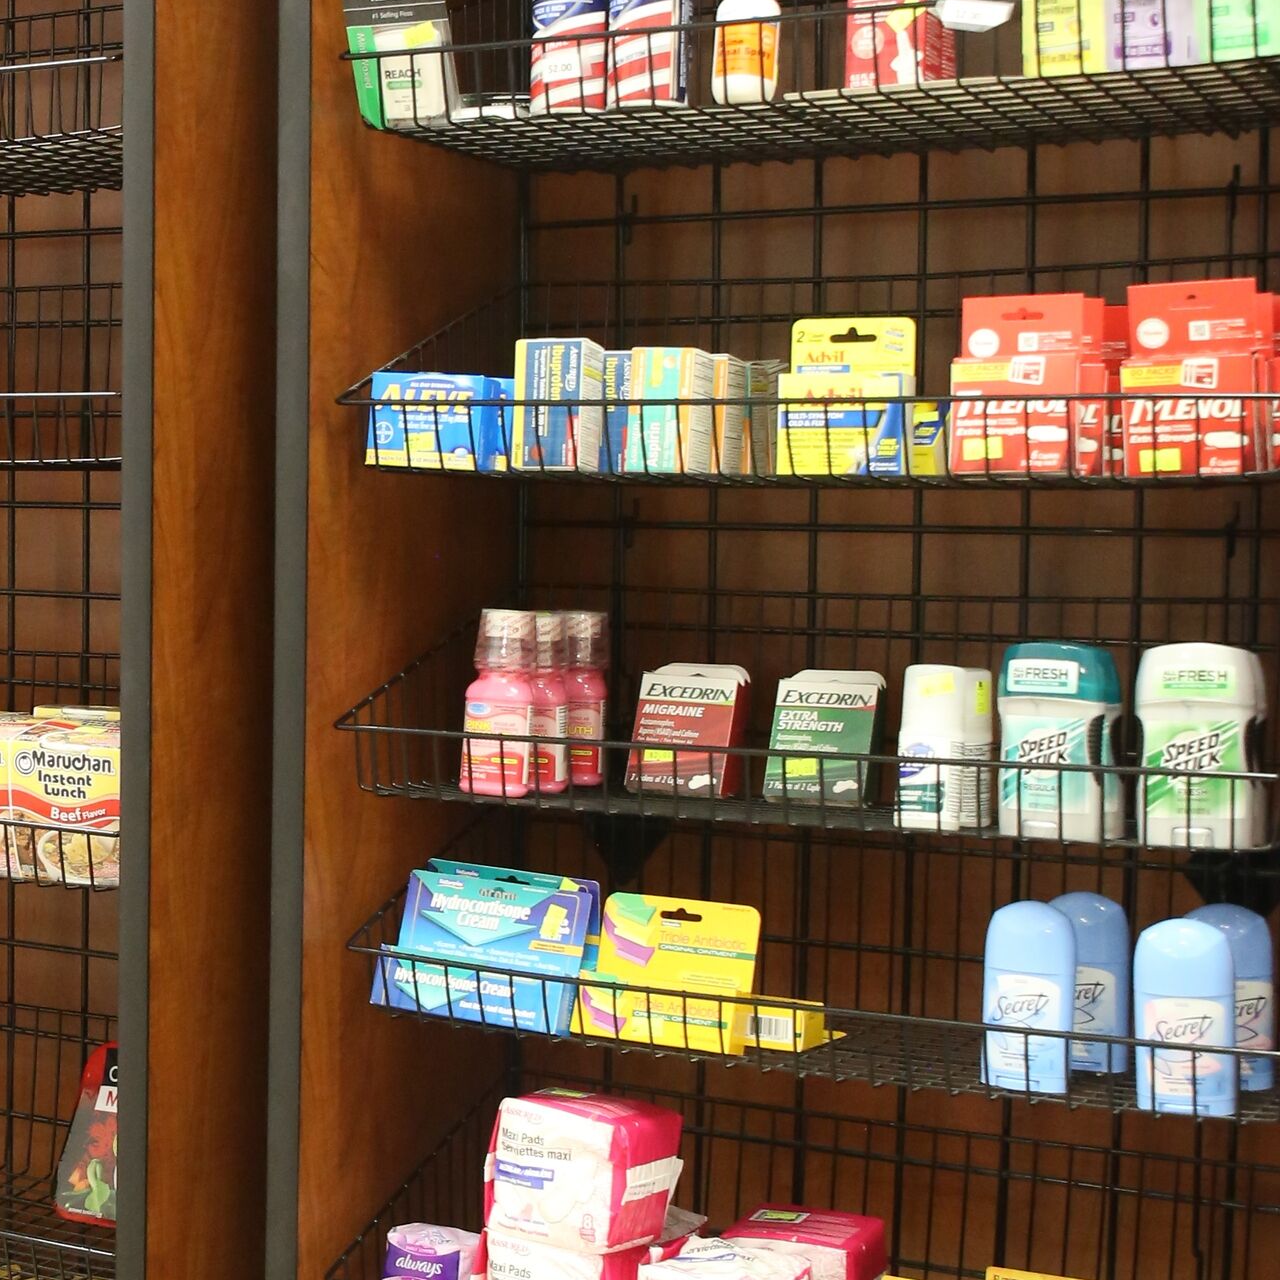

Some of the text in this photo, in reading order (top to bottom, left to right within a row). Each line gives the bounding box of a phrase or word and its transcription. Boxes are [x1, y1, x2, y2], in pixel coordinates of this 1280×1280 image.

[380, 11, 399, 19] Selling
[385, 69, 421, 80] REACH
[548, 63, 572, 74] $2.00
[796, 331, 805, 343] 2
[804, 351, 845, 363] Advil
[550, 345, 565, 401] Ibuprofen
[565, 346, 578, 392] ASSURED
[375, 384, 474, 415] ALEVE
[800, 388, 864, 408] Advil
[956, 396, 1067, 418] TYLENOL
[1127, 399, 1246, 426] TYLENOL
[647, 422, 662, 468] Aspirin
[1025, 667, 1068, 681] FRESH
[1177, 670, 1228, 682] FRESH
[646, 683, 734, 702] EXCEDRIN
[782, 690, 873, 707] EXCEDRIN
[642, 703, 705, 718] MIGRAINE
[779, 710, 818, 721] EXTRA
[467, 721, 491, 731] PINK
[777, 720, 844, 733] STRENGTH
[1019, 732, 1068, 757] SPEED
[1164, 733, 1220, 763] SPEED
[32, 750, 112, 773] Maruchan
[1024, 748, 1070, 775] STICK
[1171, 749, 1221, 780] STICK
[38, 770, 92, 787] Instant
[44, 783, 87, 799] Lunch
[50, 806, 106, 822] Beef Flavor
[430, 892, 531, 921] Hydrocortisone
[456, 911, 500, 931] Cream
[660, 930, 747, 950] Triple Antibiotic
[660, 944, 737, 958] ORIGINAL OINTMENT
[994, 994, 1048, 1021] Secret
[1154, 1016, 1213, 1043] Secret
[502, 1127, 545, 1146] Maxi Pads
[547, 1149, 572, 1161] maxi
[582, 1213, 593, 1230] 8
[395, 1254, 443, 1278] always
[508, 1265, 532, 1279] Pads
